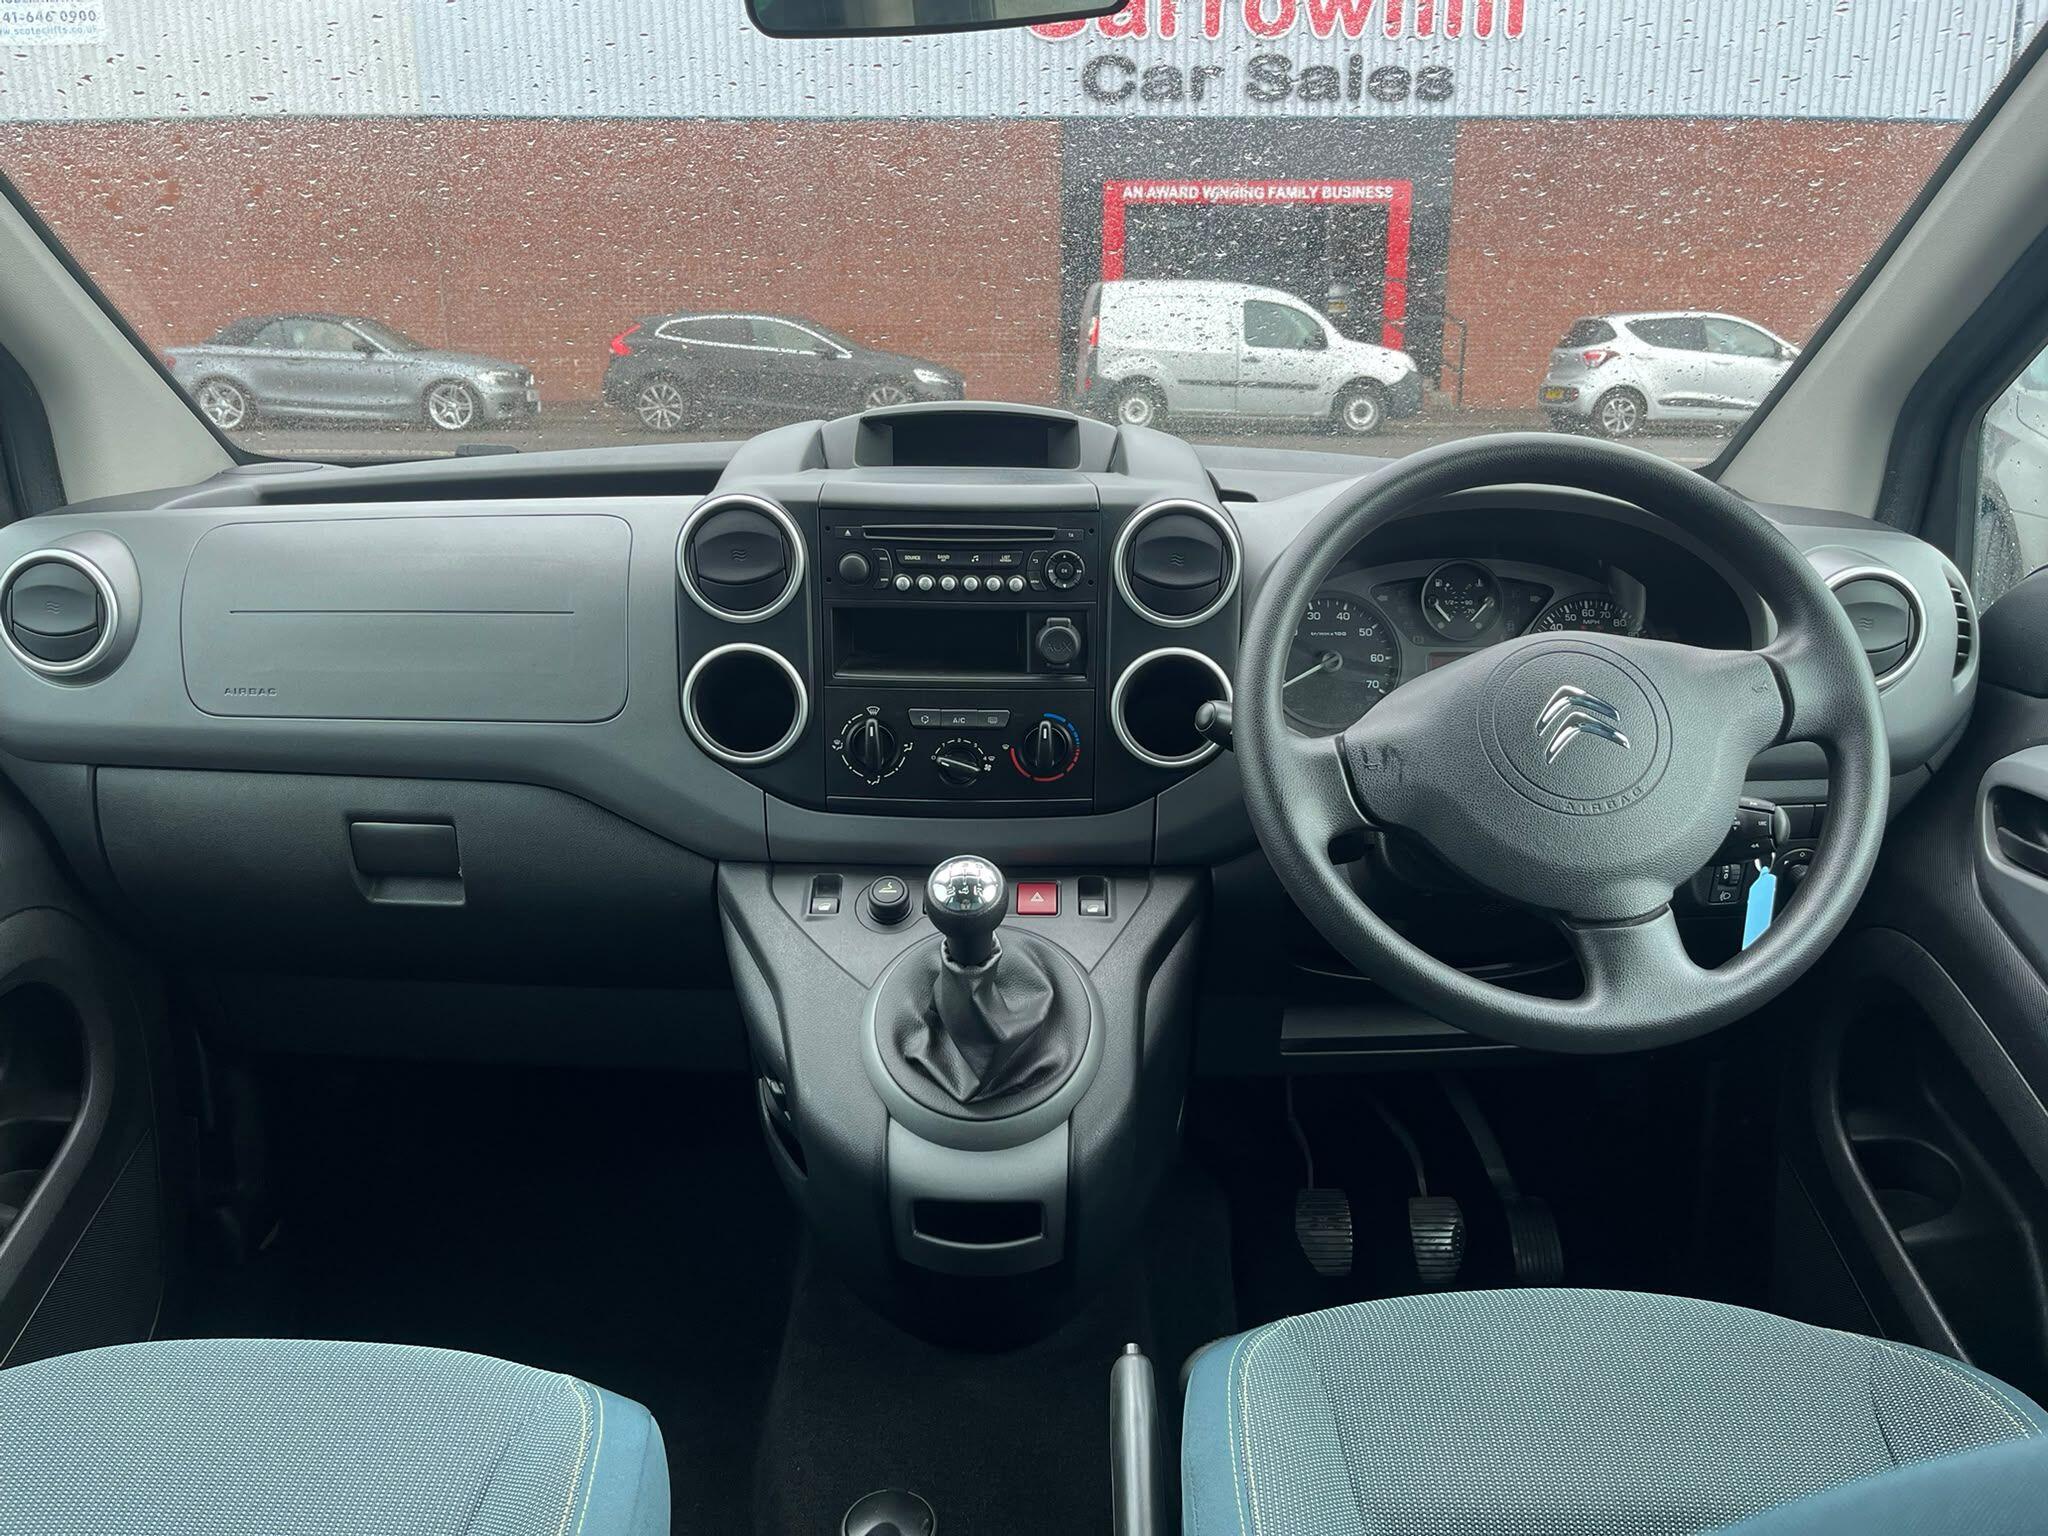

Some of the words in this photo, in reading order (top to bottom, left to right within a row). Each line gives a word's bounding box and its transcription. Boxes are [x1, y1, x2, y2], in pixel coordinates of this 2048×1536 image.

[60, 10, 97, 22] 0900
[1082, 54, 1226, 103] Car
[1246, 53, 1455, 103] Sales
[1123, 186, 1142, 199] AN
[1145, 186, 1199, 199] AWARD
[1268, 186, 1317, 199] FAMILY
[1322, 186, 1393, 199] BUSINESS
[1307, 611, 1321, 620] 30
[1336, 611, 1351, 620] 40
[1565, 613, 1577, 621] 50
[1581, 608, 1595, 617] 60
[1600, 611, 1611, 619] 70
[1549, 623, 1563, 632] 40
[1613, 619, 1627, 628] 80
[1358, 628, 1373, 637] 50
[1370, 653, 1385, 663] 60
[1366, 680, 1380, 689] 70
[223, 687, 278, 697] AIRBAG
